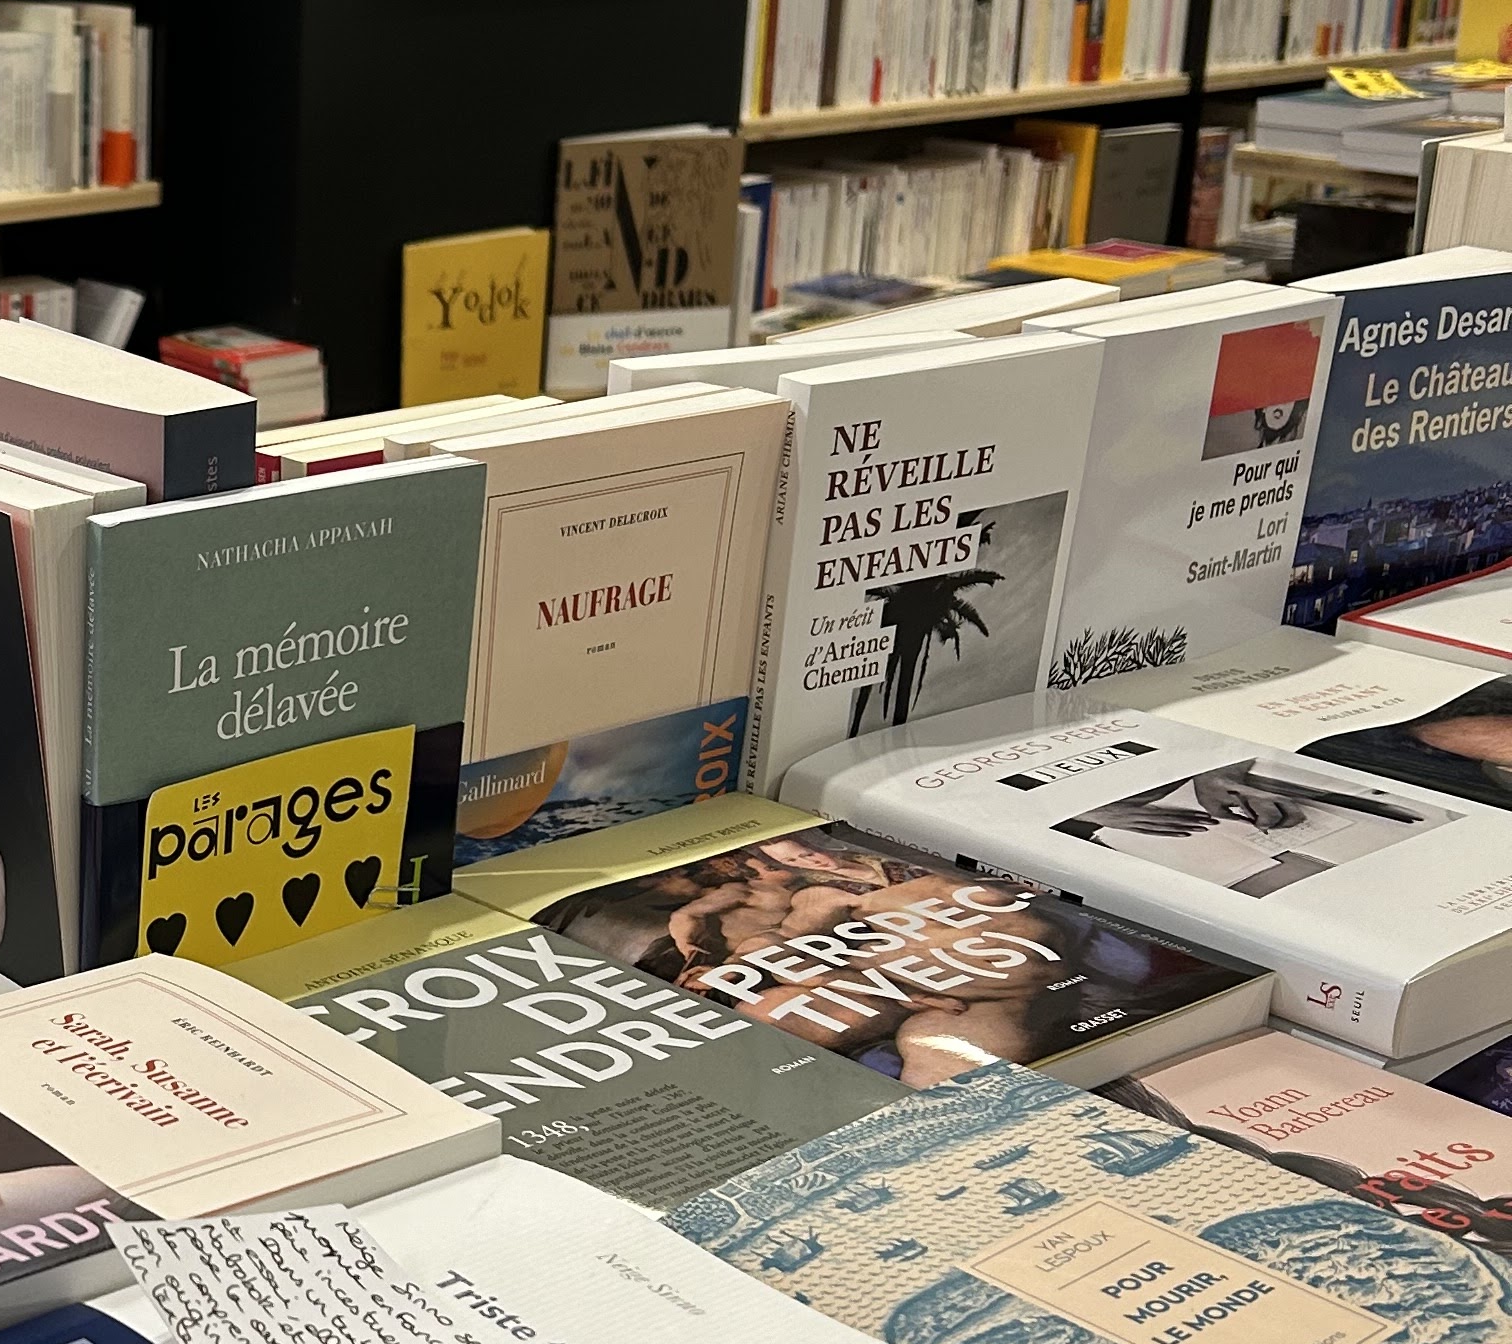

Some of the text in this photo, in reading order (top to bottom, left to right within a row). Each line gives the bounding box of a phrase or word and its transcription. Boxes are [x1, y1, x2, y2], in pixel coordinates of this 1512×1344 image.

[431, 276, 532, 331] Yodok
[1338, 310, 1429, 359] Agnès
[1364, 373, 1400, 408] Le
[829, 419, 883, 458] NE
[1350, 416, 1401, 454] des
[825, 444, 997, 502] RÉVEILLE
[1232, 450, 1300, 488] Pour qui
[559, 506, 669, 537] VINCENT DELECROIX
[819, 494, 953, 547] PAS LES
[1208, 479, 1295, 520] me prends
[195, 517, 395, 572] NATHACHA APPANAH
[1256, 511, 1289, 542] Lori
[813, 532, 974, 592] ENFANTS
[1185, 541, 1283, 585] Saint-Martin
[536, 572, 674, 631] NAUFRAGE
[810, 607, 875, 638] Un récit
[167, 605, 410, 695] La mémoire
[585, 641, 617, 655] roman
[803, 634, 891, 669] d'Ariane
[803, 658, 881, 692] Chemin
[216, 669, 359, 741] délavée
[913, 716, 1142, 790] GEORGES PEREC
[147, 768, 393, 880] parages
[193, 791, 221, 813] LES
[769, 931, 1062, 1036] TIVE(S)
[1046, 974, 1089, 993] ROMAN
[1069, 1007, 1128, 1034] GRASSET
[1350, 989, 1366, 1024] SEUIL
[49, 1010, 251, 1132] Sarah, Susanne
[203, 1032, 275, 1080] REINHARDT
[771, 1055, 818, 1076] ROMAN
[60, 1045, 183, 1130] l'écrivain
[1207, 1087, 1311, 1128] Yoann
[1249, 1084, 1396, 1142] Barbereau
[1033, 1231, 1075, 1255] YAN
[1036, 1229, 1116, 1274] LESPOUX
[1101, 1260, 1175, 1301] POUR
[1123, 1273, 1229, 1326] MOURIR,
[435, 1269, 540, 1342] Triste
[1183, 1279, 1276, 1334] MONDE
